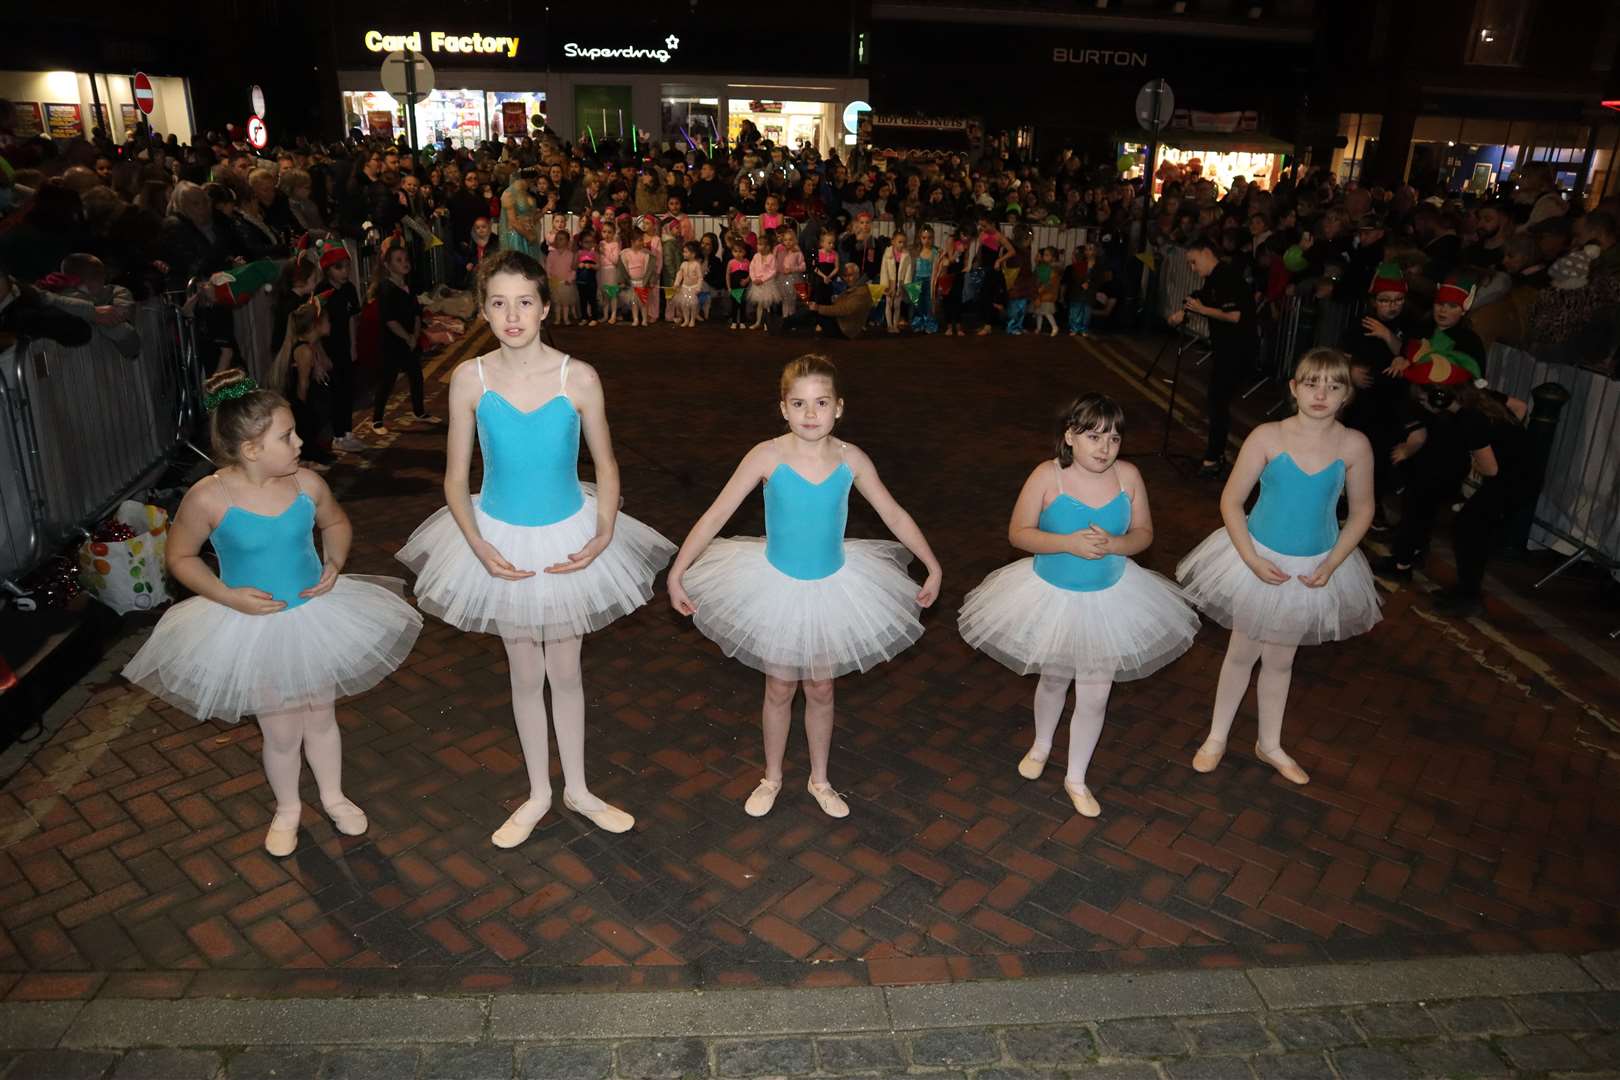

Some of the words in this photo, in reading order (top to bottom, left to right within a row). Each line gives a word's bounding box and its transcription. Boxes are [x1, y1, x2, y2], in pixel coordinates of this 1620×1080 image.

[365, 30, 422, 53] Card
[431, 31, 520, 58] Factory
[563, 42, 672, 63] Superdrug
[1052, 47, 1149, 67] BURTON
[901, 115, 962, 128] CHESTNUTS
